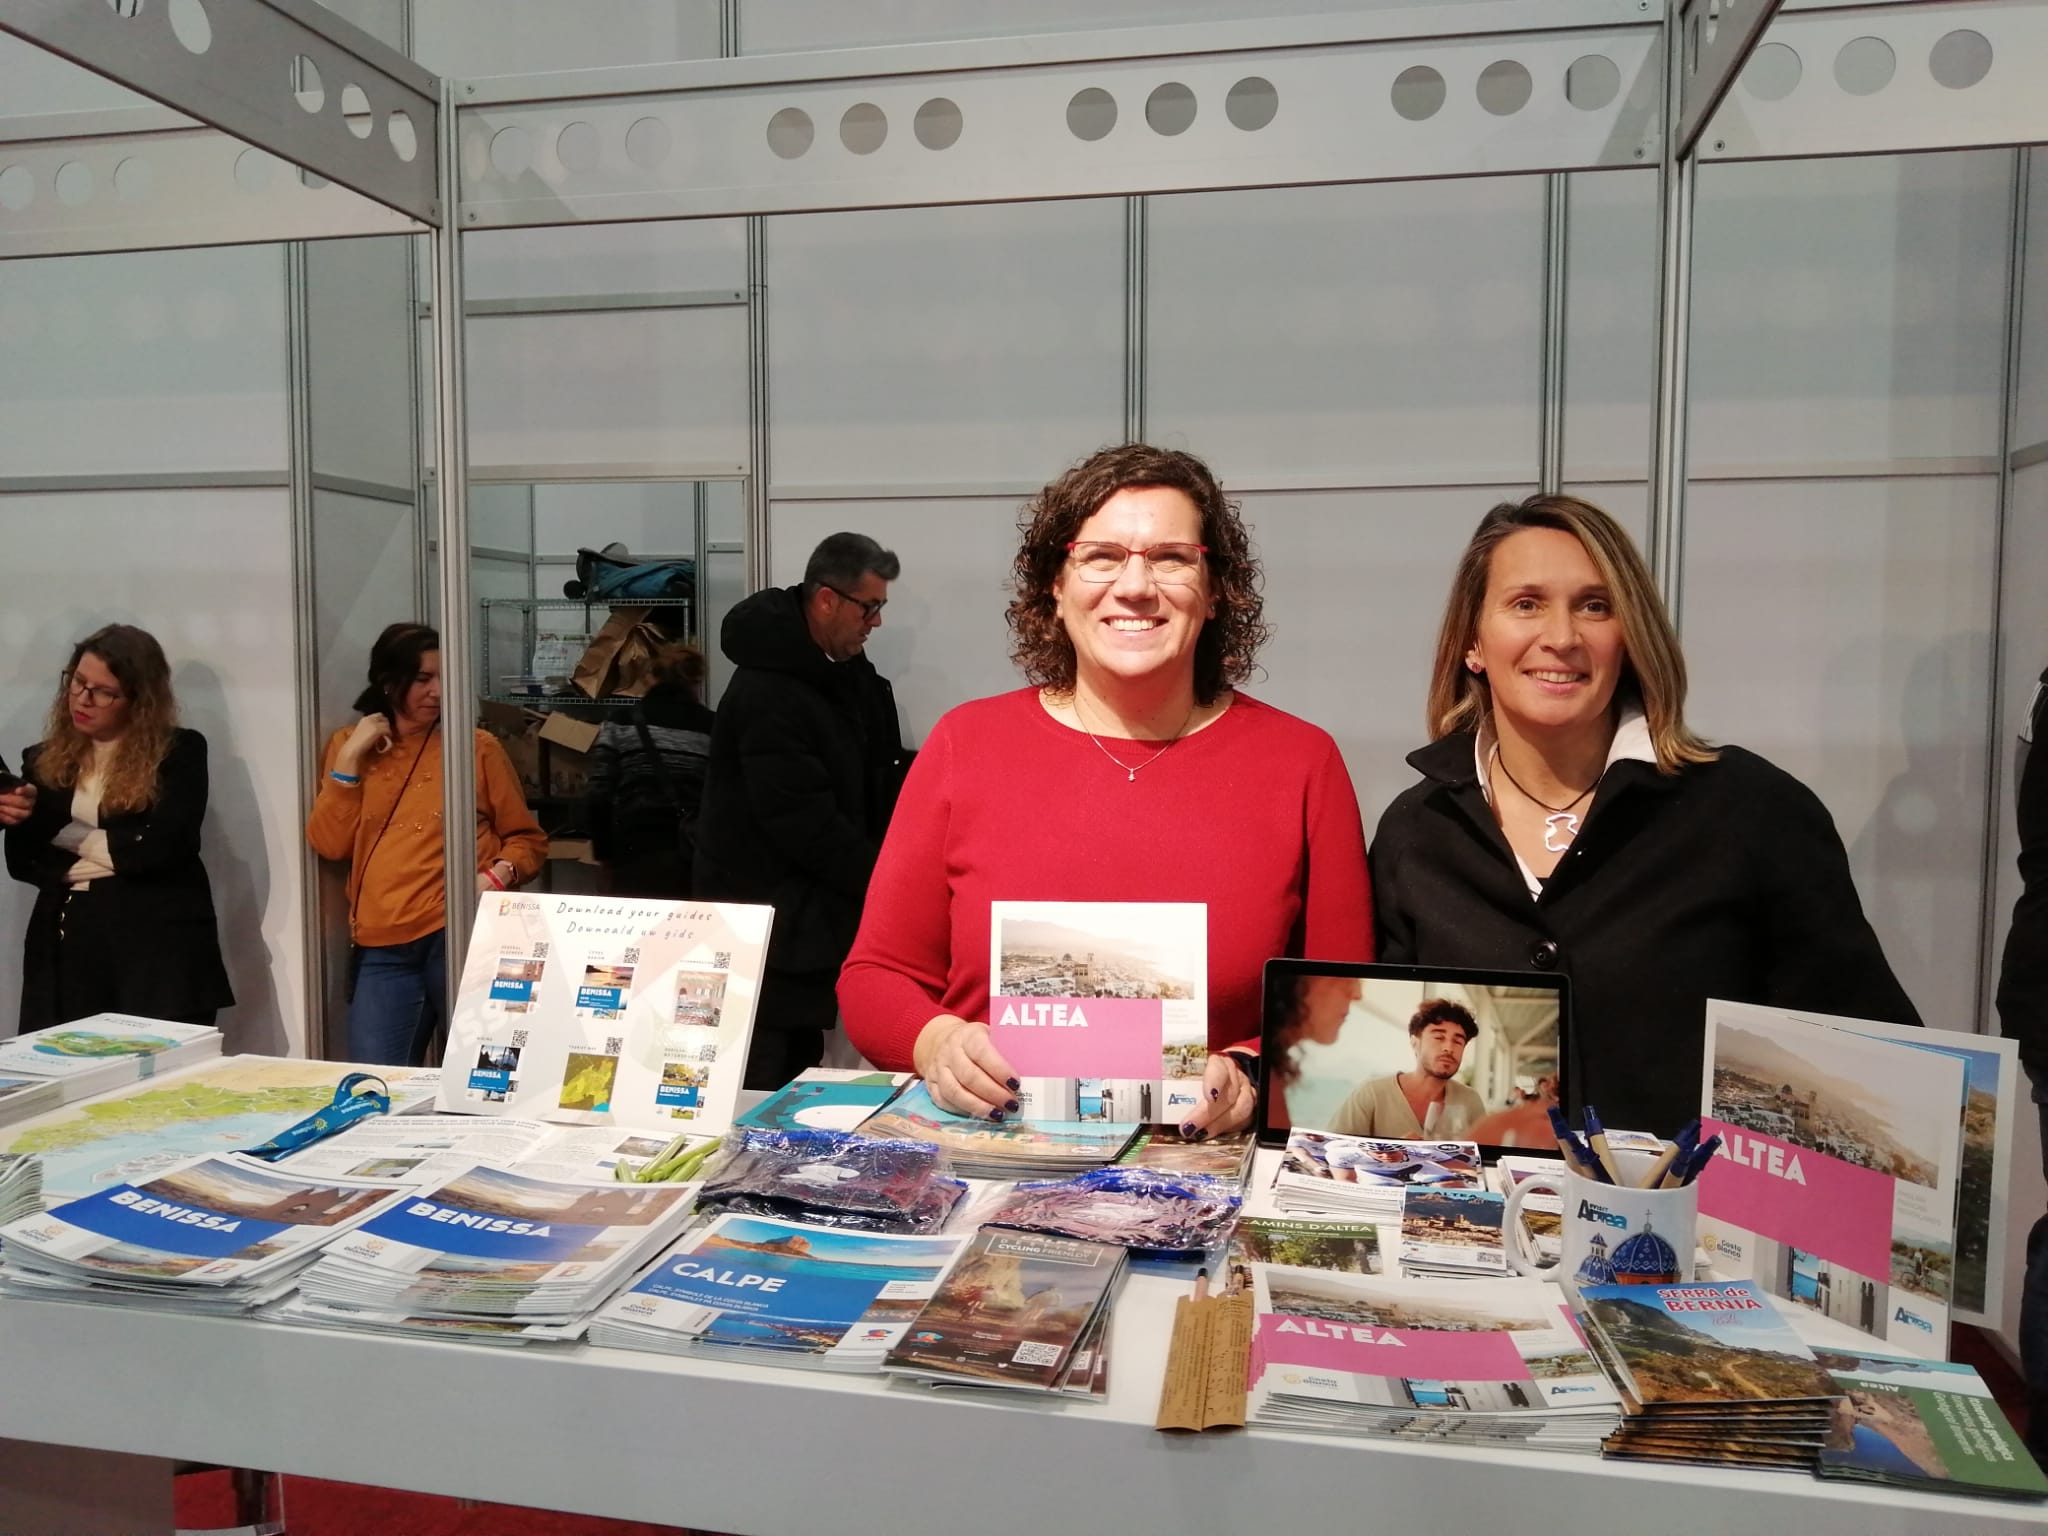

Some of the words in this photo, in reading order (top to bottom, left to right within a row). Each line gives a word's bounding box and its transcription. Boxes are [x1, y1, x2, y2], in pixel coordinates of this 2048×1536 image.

[512, 902, 541, 911] BENISSA
[556, 902, 623, 915] Download
[628, 909, 660, 920] your
[667, 910, 712, 921] guides
[664, 929, 694, 940] gids
[494, 981, 524, 990] BENISSA
[581, 988, 613, 997] BENISSA
[1000, 1003, 1089, 1027] ALTEA
[472, 1070, 502, 1079] BENISSA
[660, 1086, 690, 1095] BENISSA
[1714, 1129, 1807, 1186] ALTEA
[108, 1190, 243, 1234] BENISSA
[406, 1202, 552, 1238] BENISSA
[1240, 1218, 1304, 1229] CAMINS
[1309, 1223, 1372, 1232] D'ALTEA
[998, 1243, 1042, 1253] CYCLING
[672, 1262, 788, 1293] CALPE
[1657, 1287, 1721, 1299] SERRA
[1724, 1286, 1750, 1298] de
[1664, 1298, 1763, 1312] BERNIA
[1275, 1319, 1409, 1348] ALTEA
[1859, 1381, 1899, 1393] Altea
